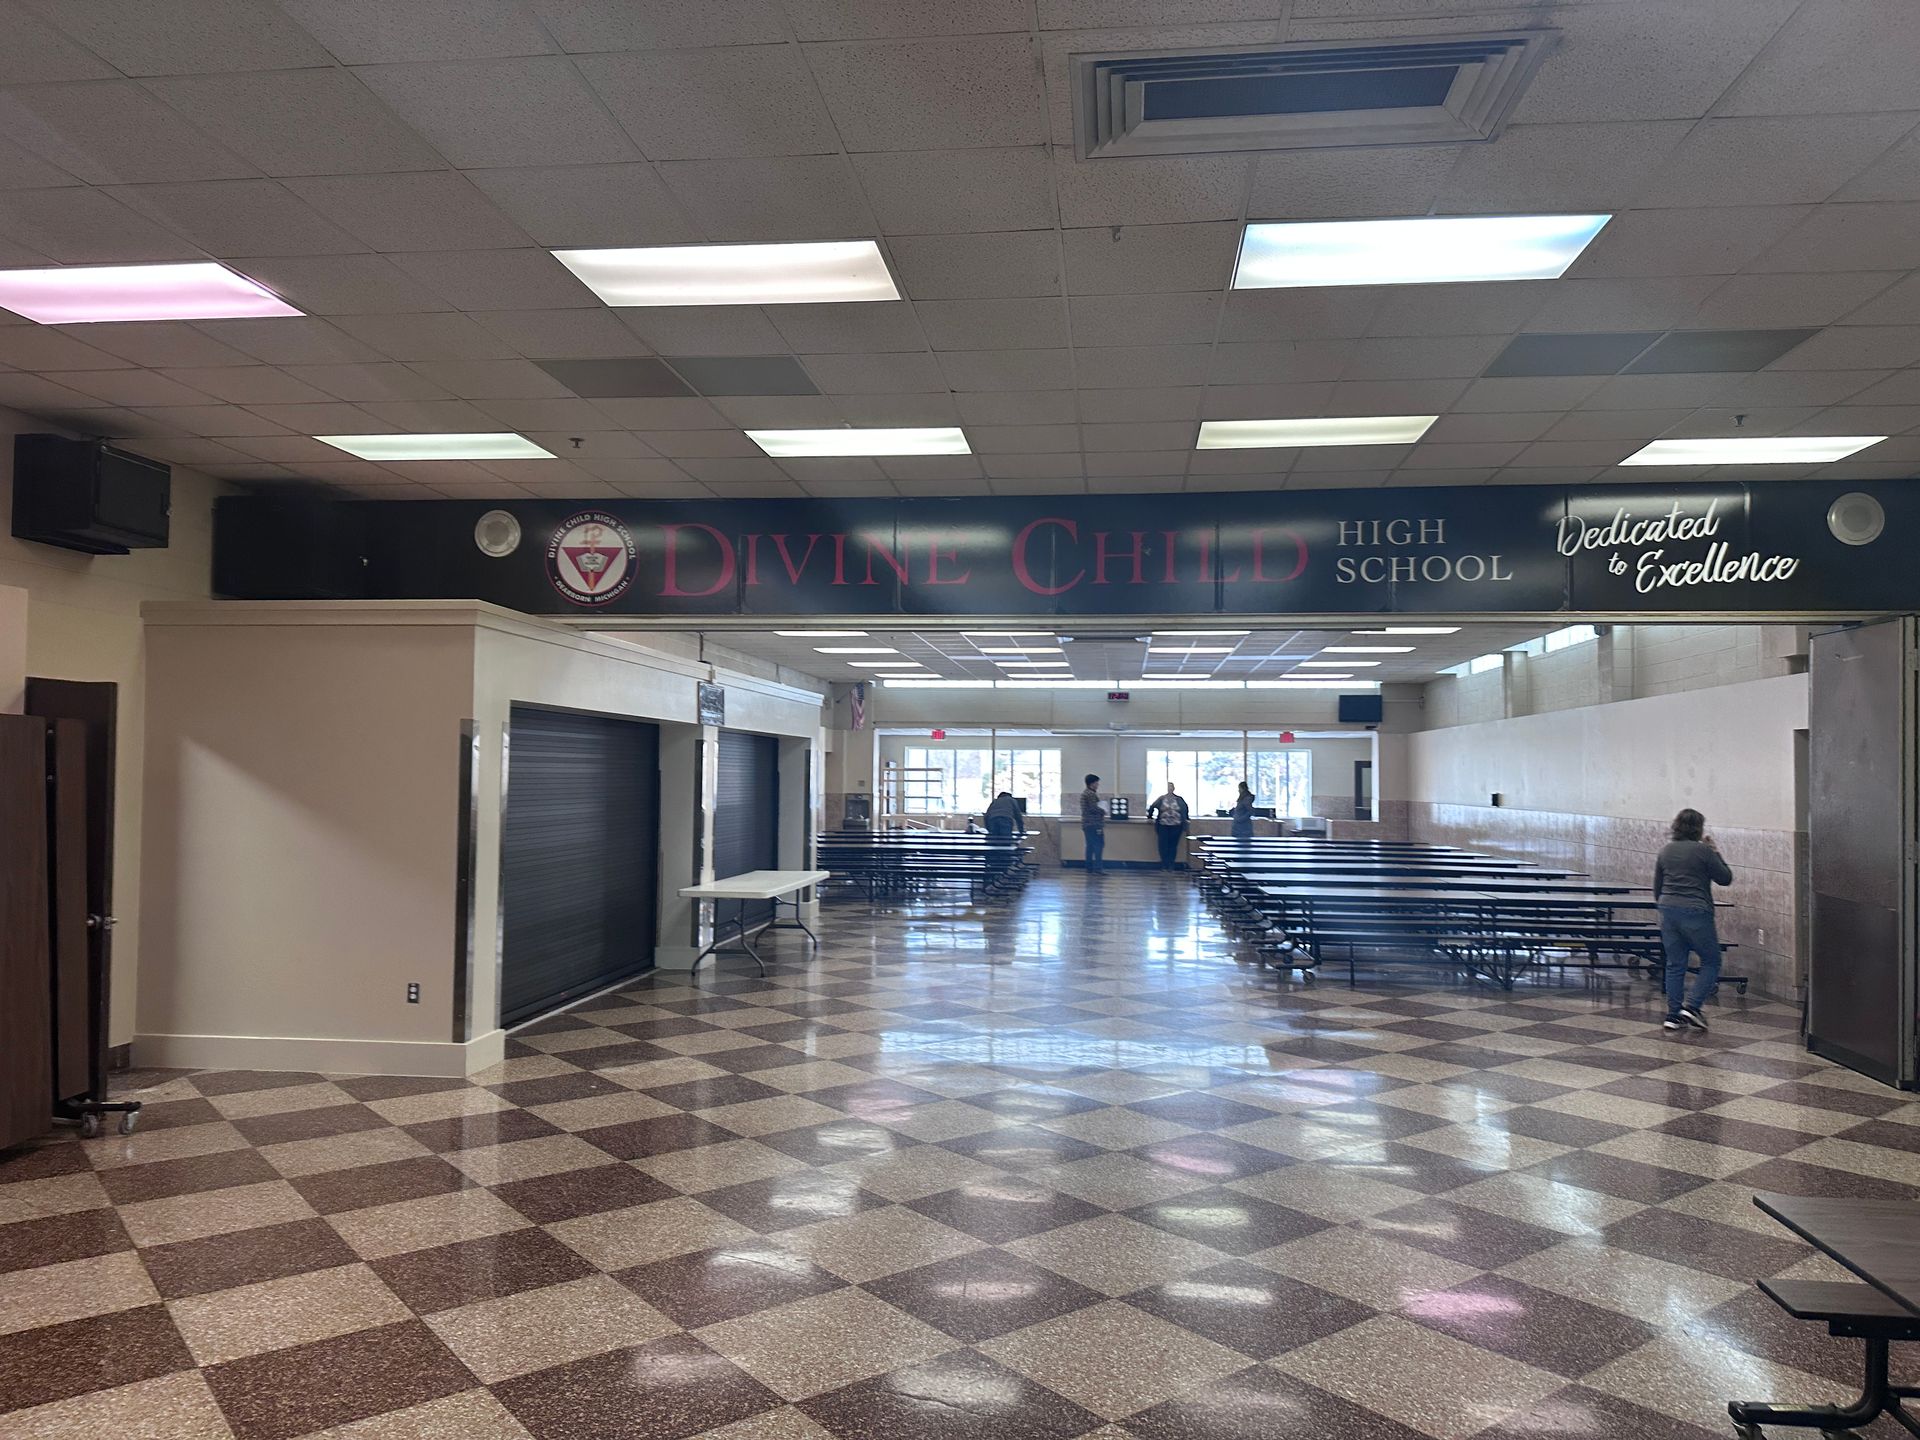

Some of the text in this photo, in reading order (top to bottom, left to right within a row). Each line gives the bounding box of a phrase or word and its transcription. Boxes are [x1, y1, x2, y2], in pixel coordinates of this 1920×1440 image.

[548, 514, 636, 559] DIVINE CHILD HIGH SCHOOL
[1337, 518, 1448, 546] HIGH
[1555, 498, 1720, 557] Dedicated
[1336, 555, 1513, 584] SCHOOL
[1609, 542, 1799, 594] to Excellence
[594, 580, 628, 602] MICHIGAN
